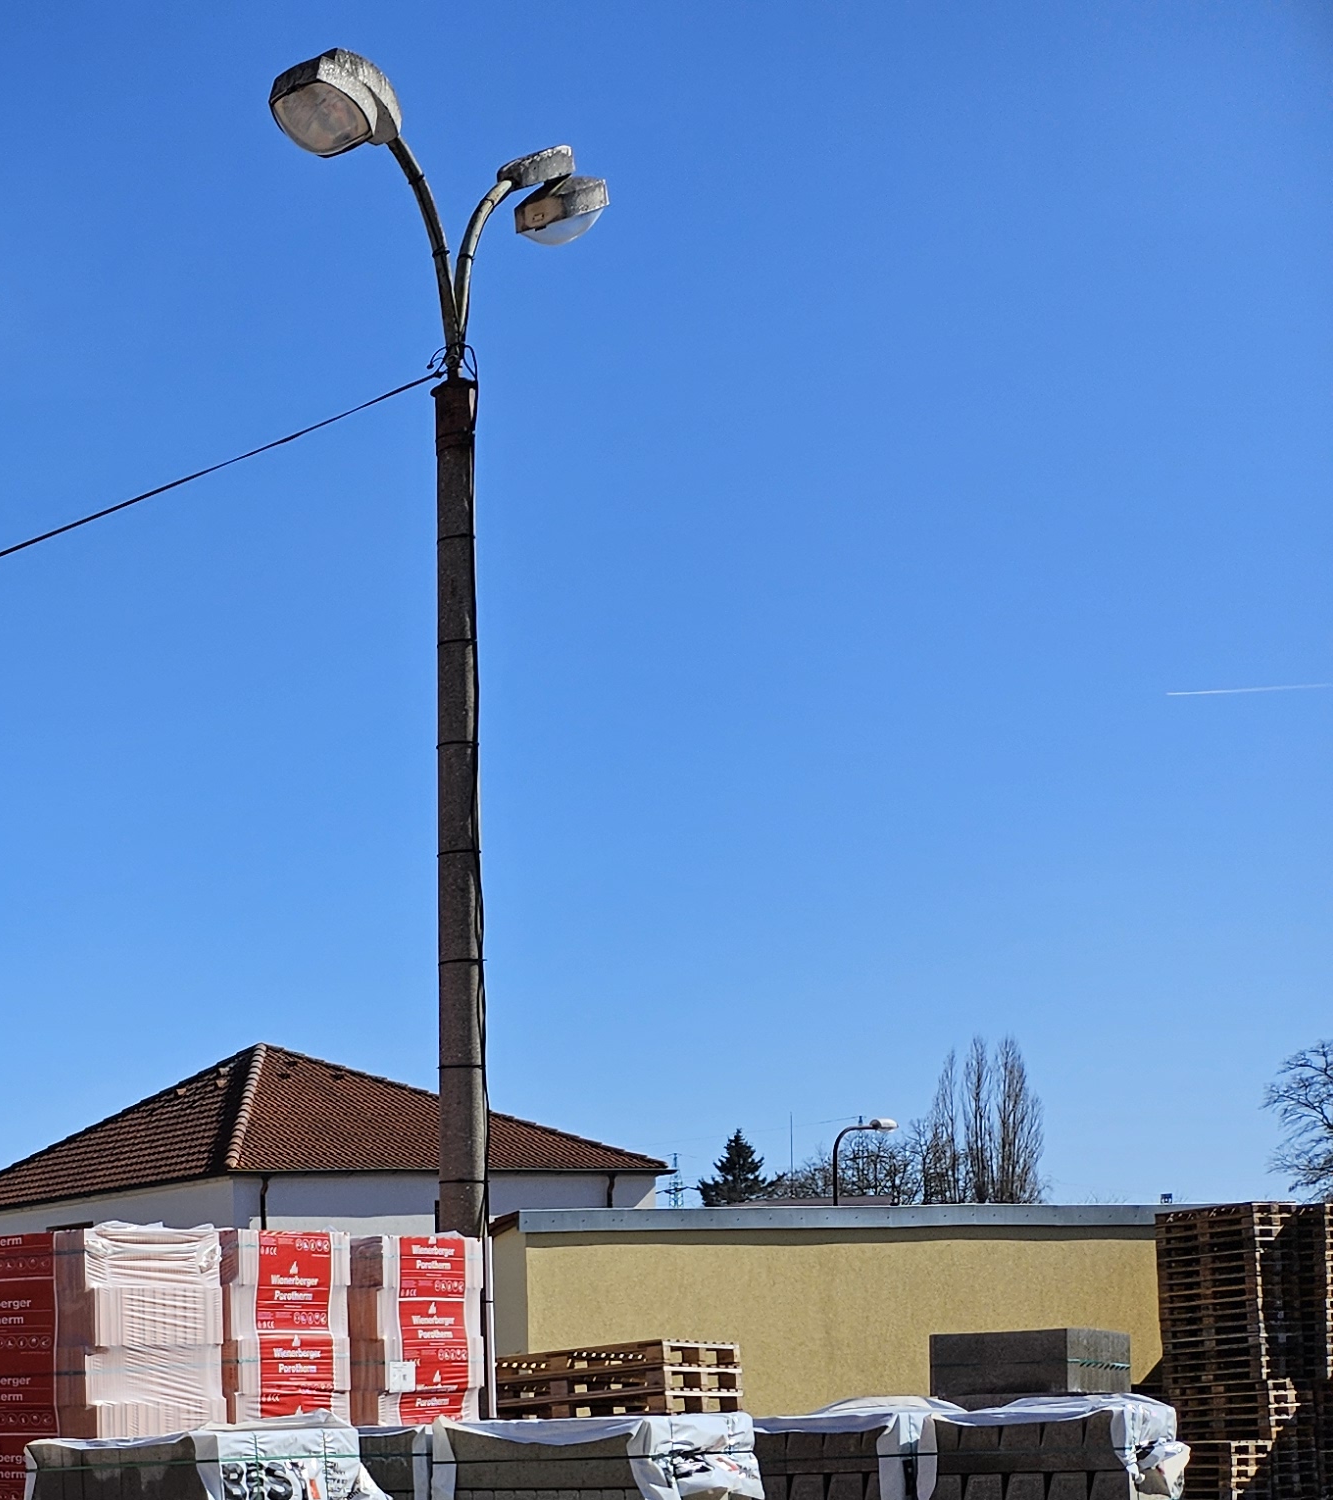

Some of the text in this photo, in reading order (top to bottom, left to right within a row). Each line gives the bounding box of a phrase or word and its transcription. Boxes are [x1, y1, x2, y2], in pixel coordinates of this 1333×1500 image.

[412, 1245, 455, 1256] Wienerberger
[416, 1261, 451, 1270] Porotherm
[271, 1275, 318, 1287] Wienerberger
[274, 1291, 312, 1300] Porotherm
[412, 1316, 455, 1325] Wienerberger
[418, 1330, 453, 1339] Porotherm
[273, 1348, 321, 1359] Wienerberger
[279, 1364, 317, 1373] Porotherm
[415, 1398, 449, 1407] Porotherm
